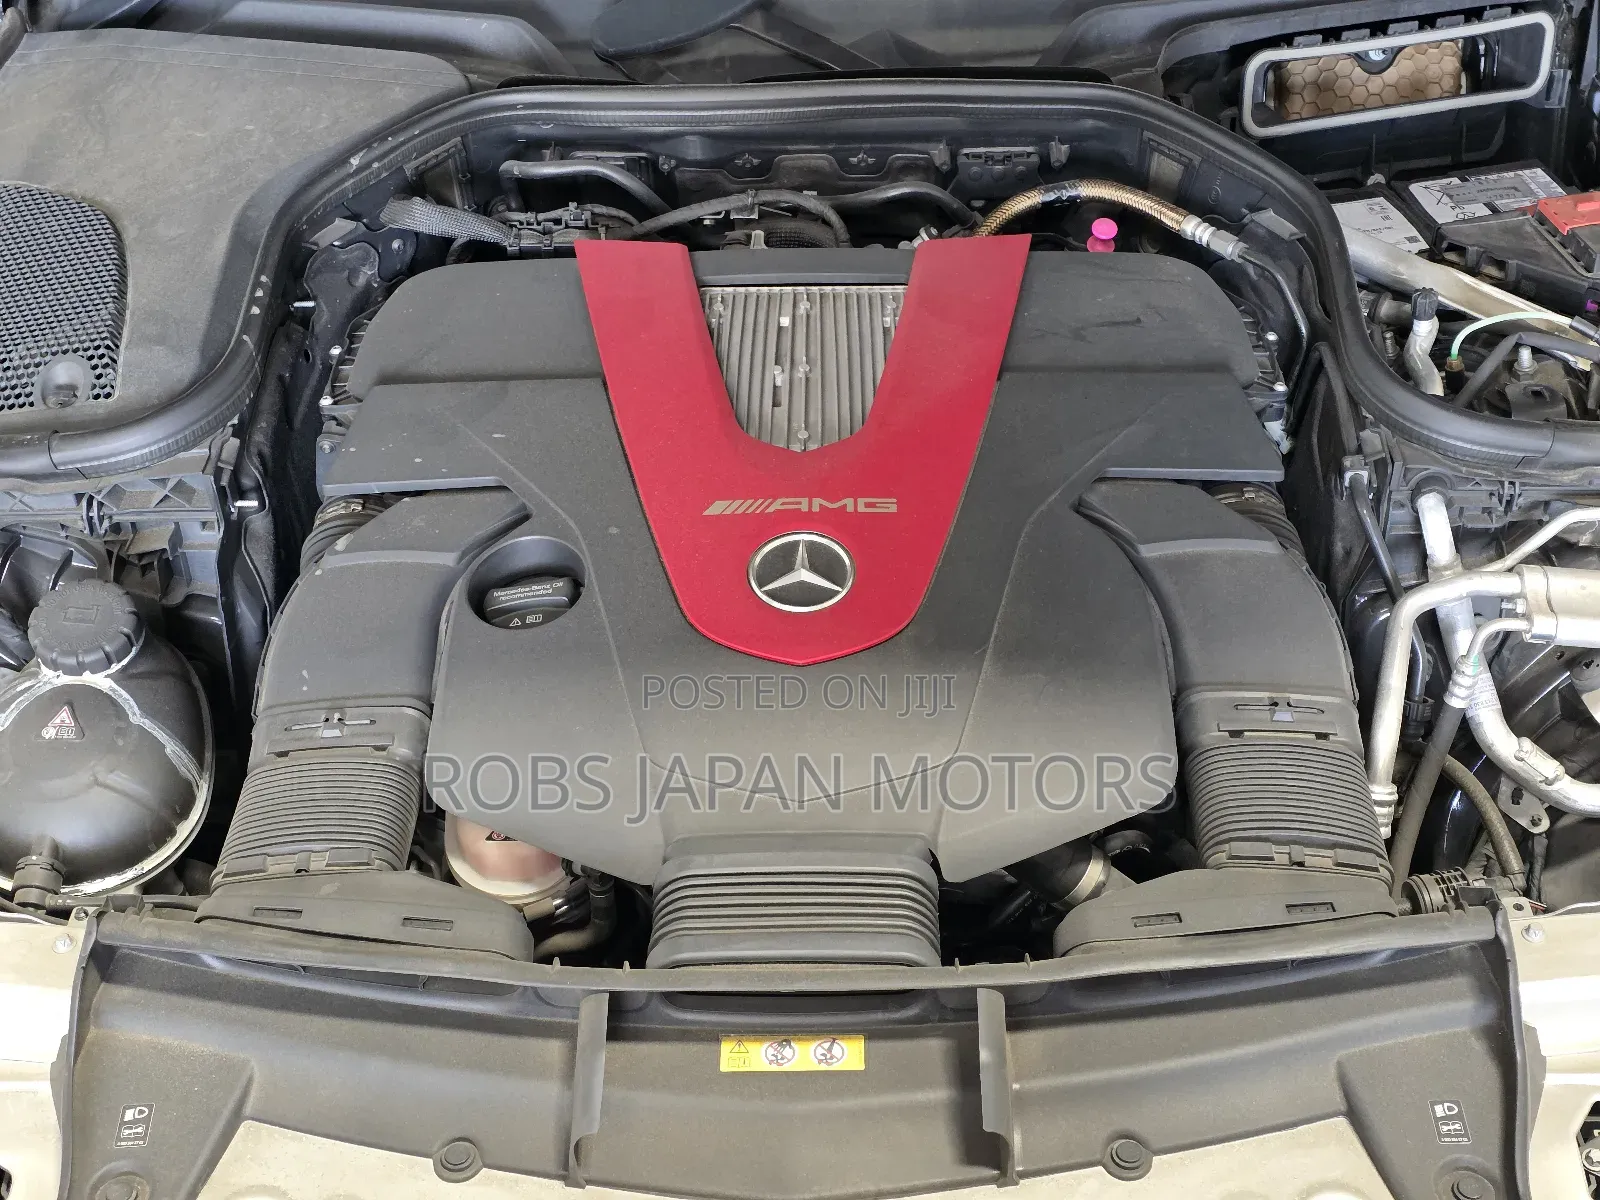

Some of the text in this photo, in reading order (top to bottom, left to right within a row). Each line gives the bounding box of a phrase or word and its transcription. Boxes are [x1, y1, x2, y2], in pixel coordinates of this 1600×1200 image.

[764, 497, 898, 513] AMG
[493, 584, 551, 597] Mercedes-Benz
[500, 588, 552, 600] recommended
